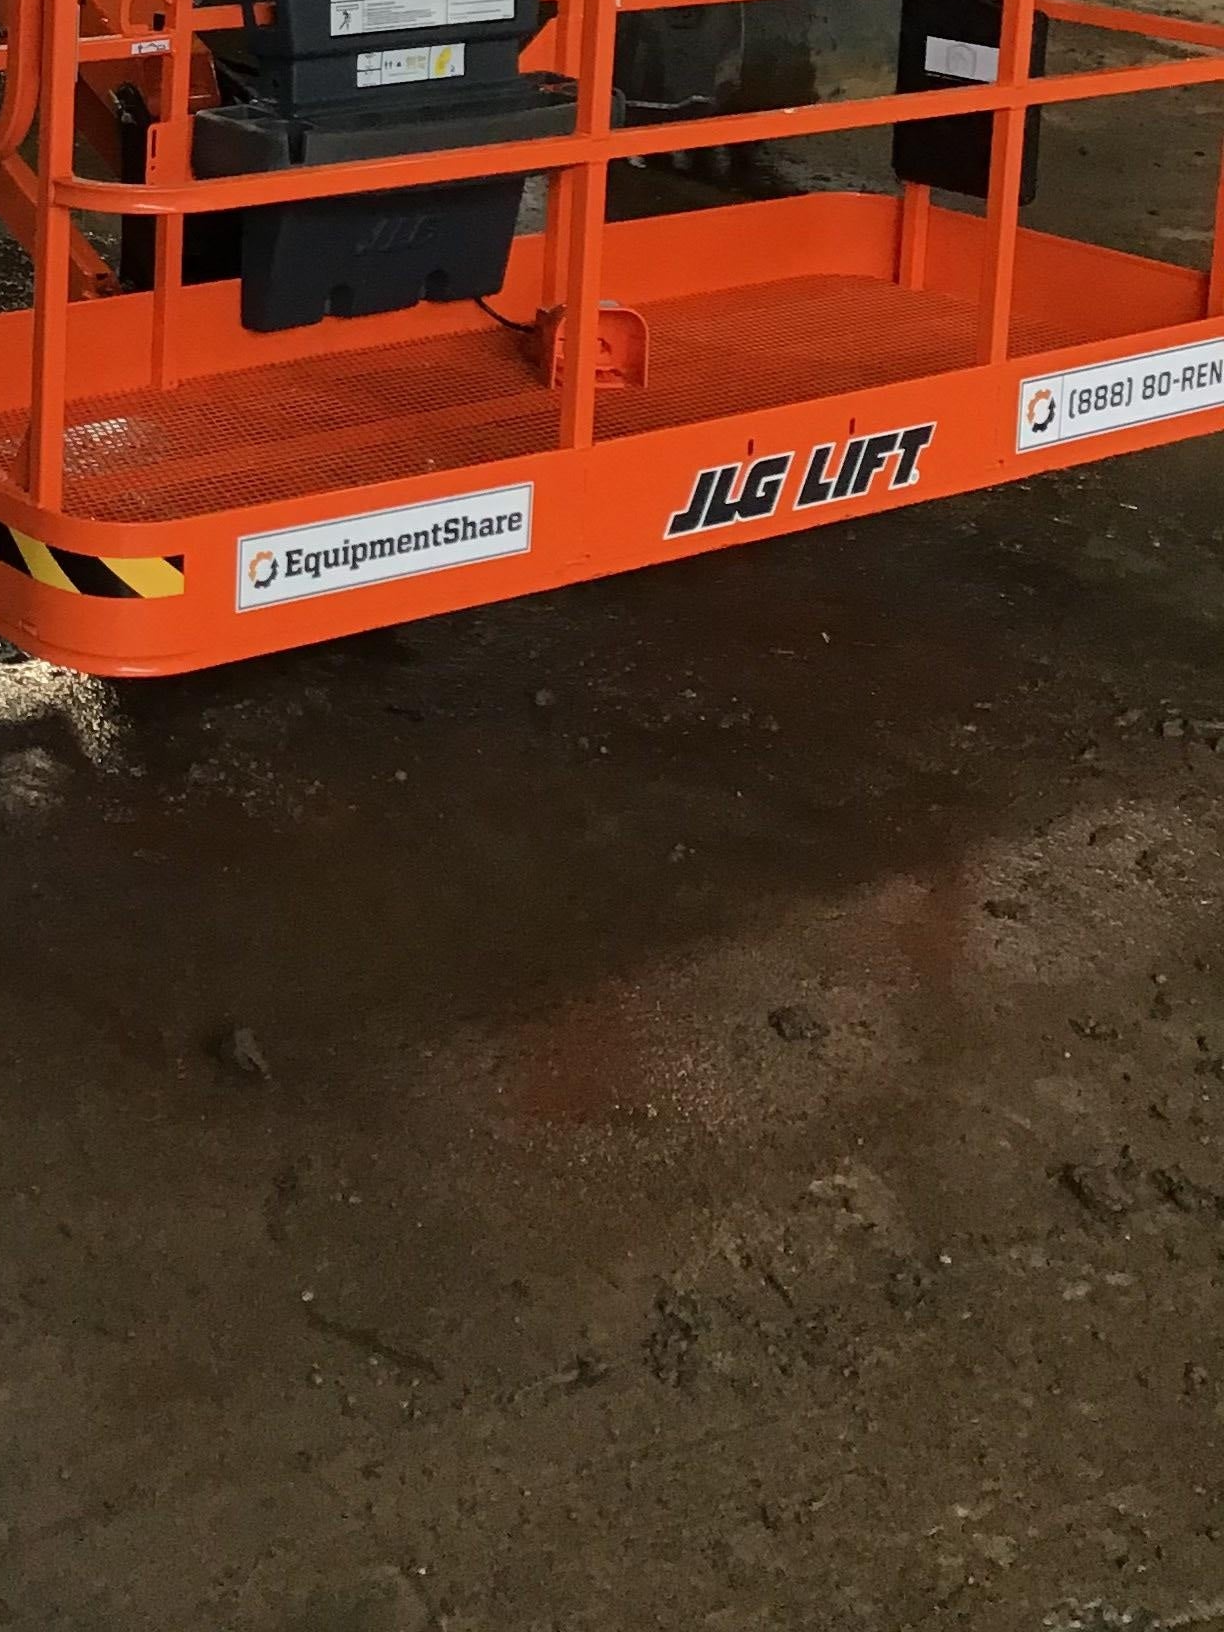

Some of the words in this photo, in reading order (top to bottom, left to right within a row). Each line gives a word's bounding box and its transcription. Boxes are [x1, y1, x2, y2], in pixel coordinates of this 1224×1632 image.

[1069, 376, 1134, 419] (888)
[664, 451, 795, 539] JLG
[793, 422, 937, 510] LIFT
[284, 510, 524, 579] EquipmentShare
